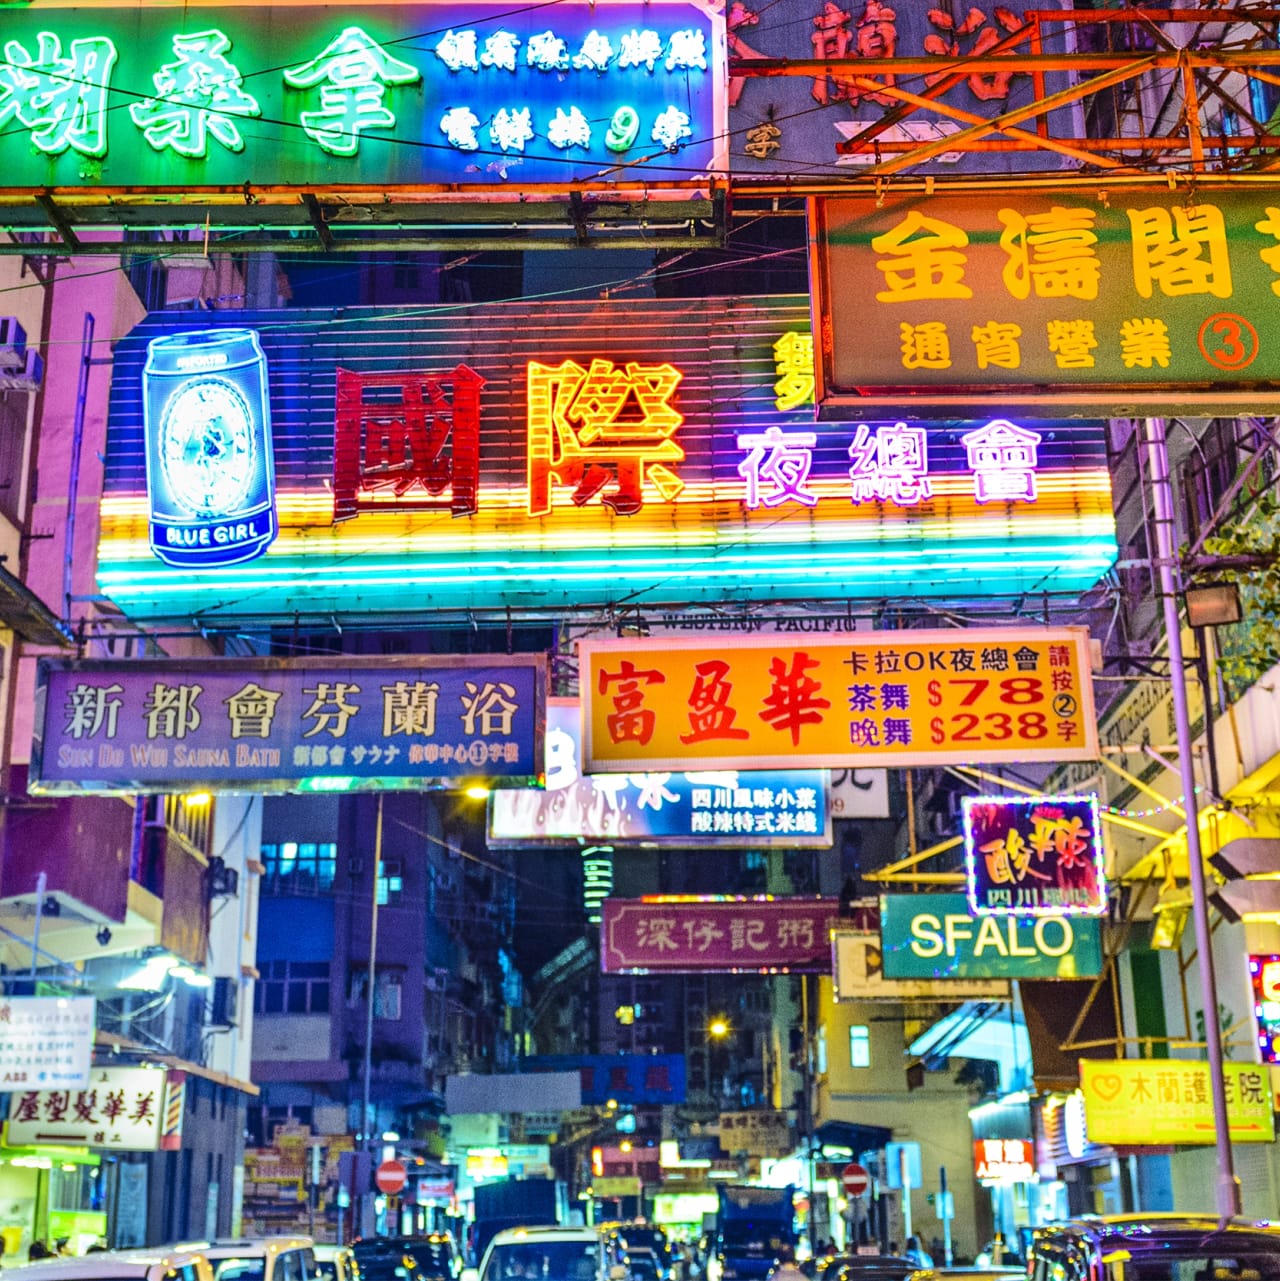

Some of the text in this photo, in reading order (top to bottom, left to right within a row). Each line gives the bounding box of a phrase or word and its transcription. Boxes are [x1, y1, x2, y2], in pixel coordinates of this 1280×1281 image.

[736, 419, 1041, 510] 夜總會
[166, 522, 257, 545] BLUE GIRL
[843, 646, 1040, 674] 卡拉OK夜總會
[64, 681, 519, 740] 新都會芬蘭浴
[598, 652, 831, 748] 富盈華
[847, 683, 910, 713] 茶舞
[850, 717, 912, 747] 晚舞
[910, 913, 1074, 958] SFALO
